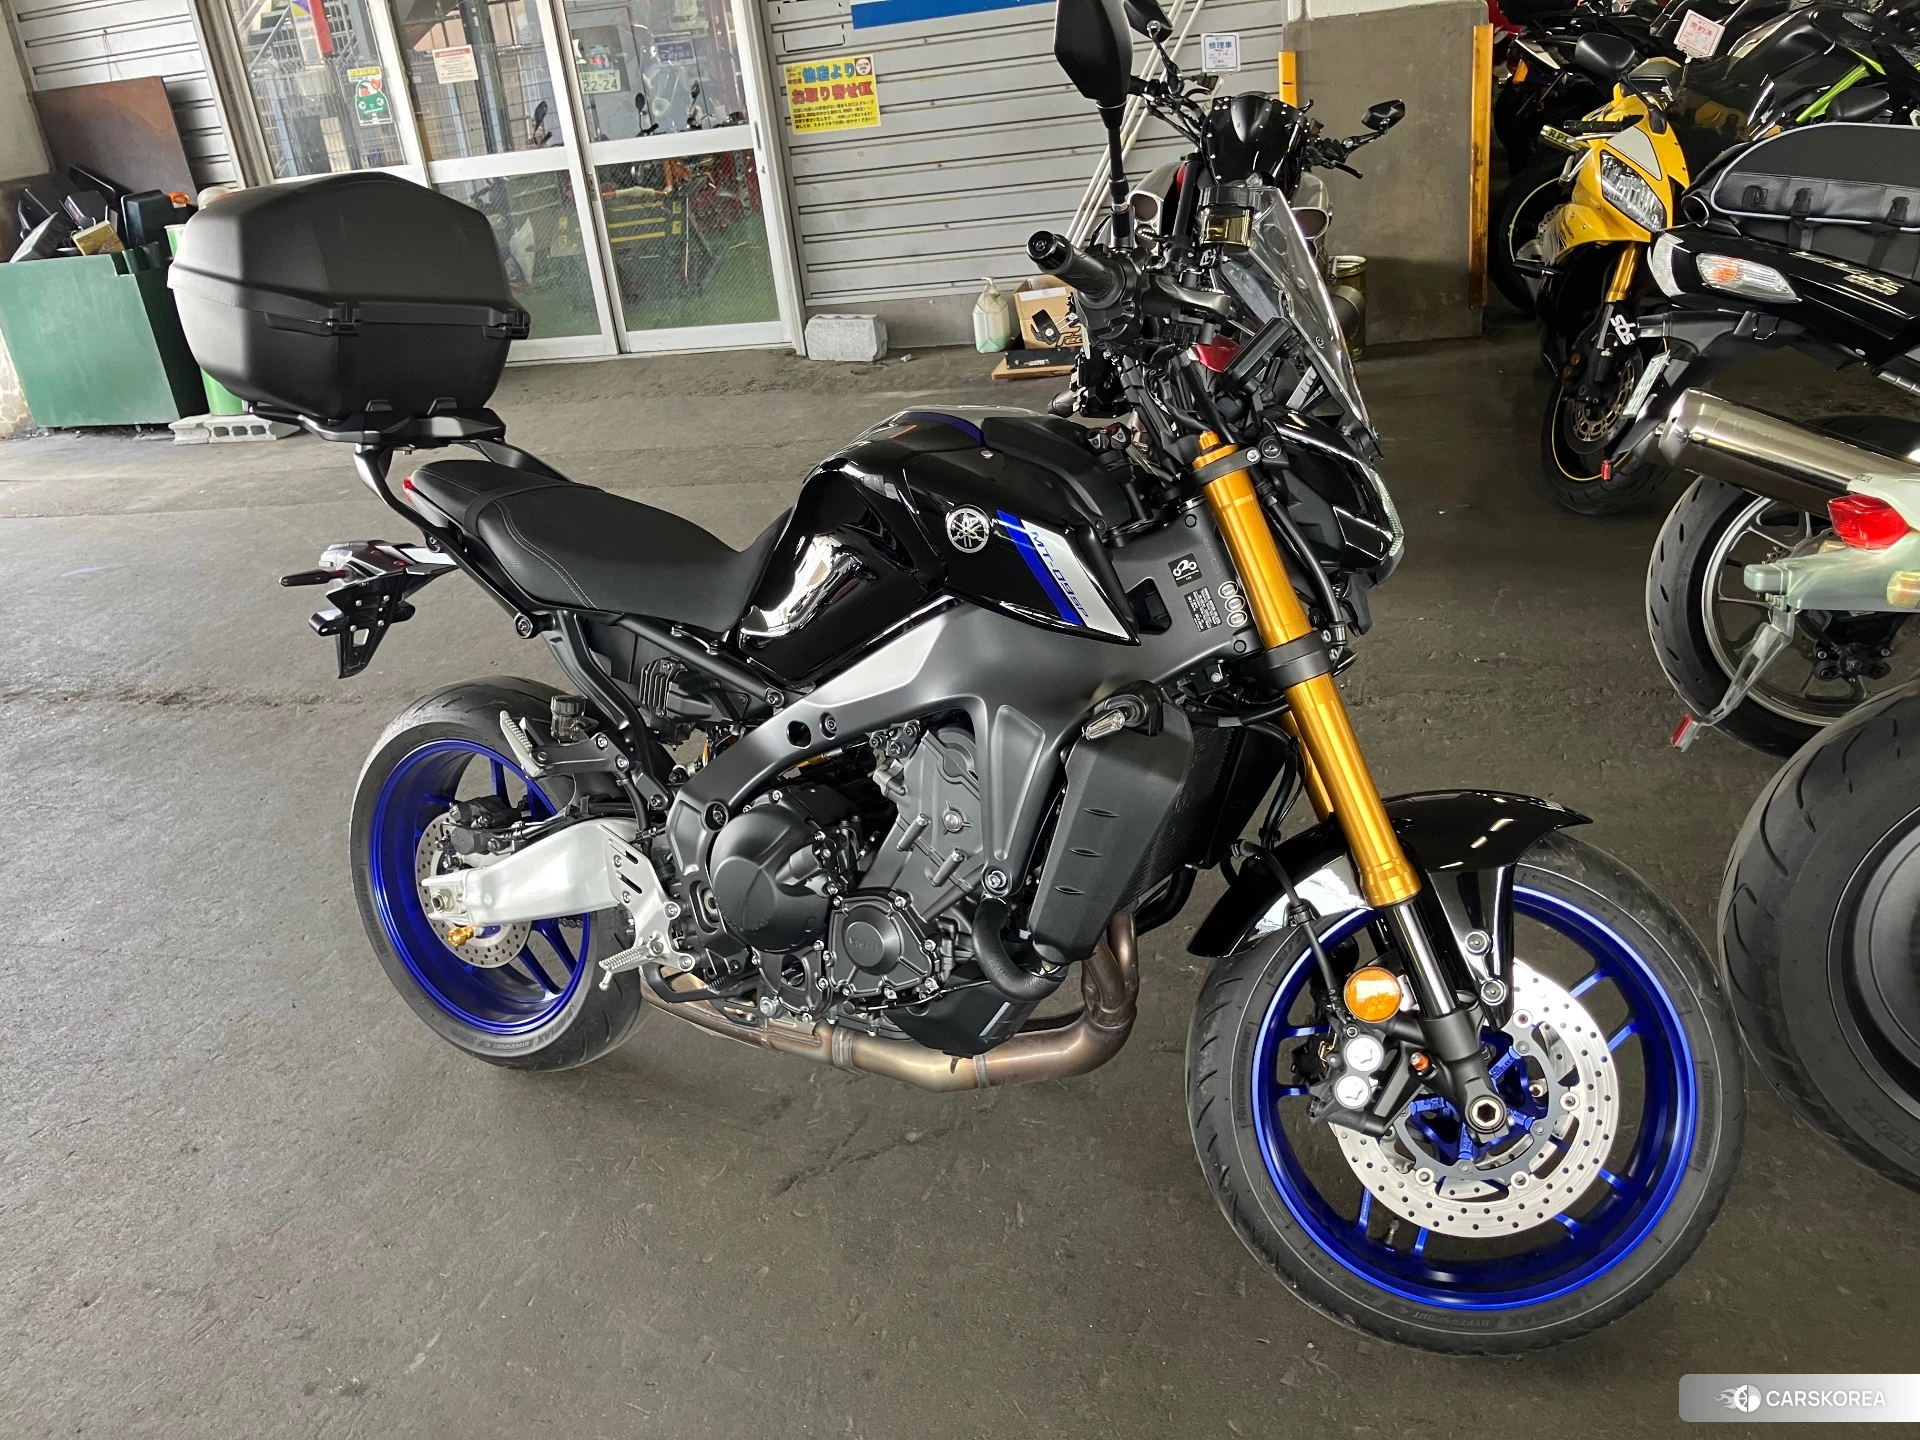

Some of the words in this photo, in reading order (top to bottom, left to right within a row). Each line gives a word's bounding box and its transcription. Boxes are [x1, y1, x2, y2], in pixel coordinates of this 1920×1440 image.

[802, 63, 855, 84] 他店より
[583, 79, 618, 92] 22-24
[791, 81, 874, 105] お取り寄せOK
[1610, 314, 1637, 345] sbs
